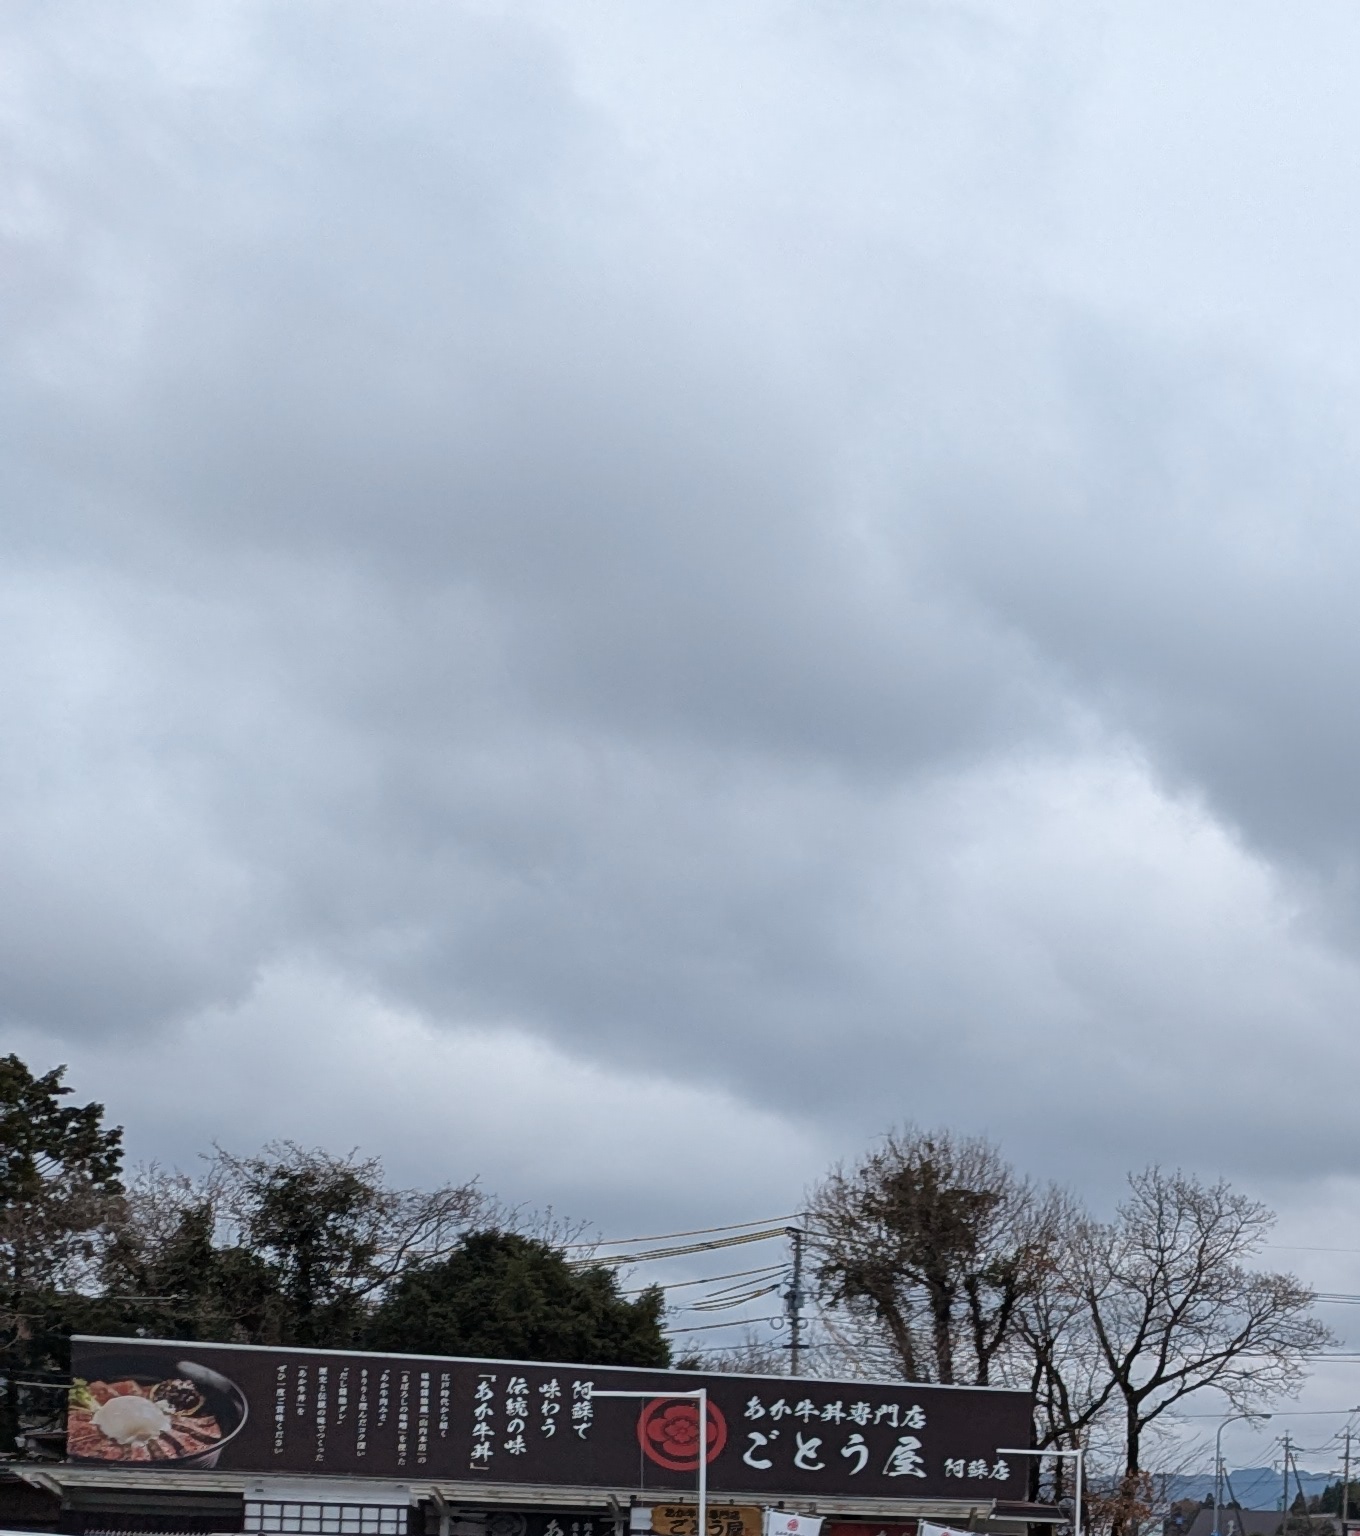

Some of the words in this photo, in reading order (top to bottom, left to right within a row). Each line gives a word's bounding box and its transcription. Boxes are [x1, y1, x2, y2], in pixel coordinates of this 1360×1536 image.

[503, 1376, 530, 1456] 伝統の味
[538, 1378, 562, 1439] 味わう
[743, 1396, 927, 1430] あか牛丼専門店
[742, 1429, 928, 1479] ごとう屋
[944, 1458, 1011, 1481] 阿蘇店
